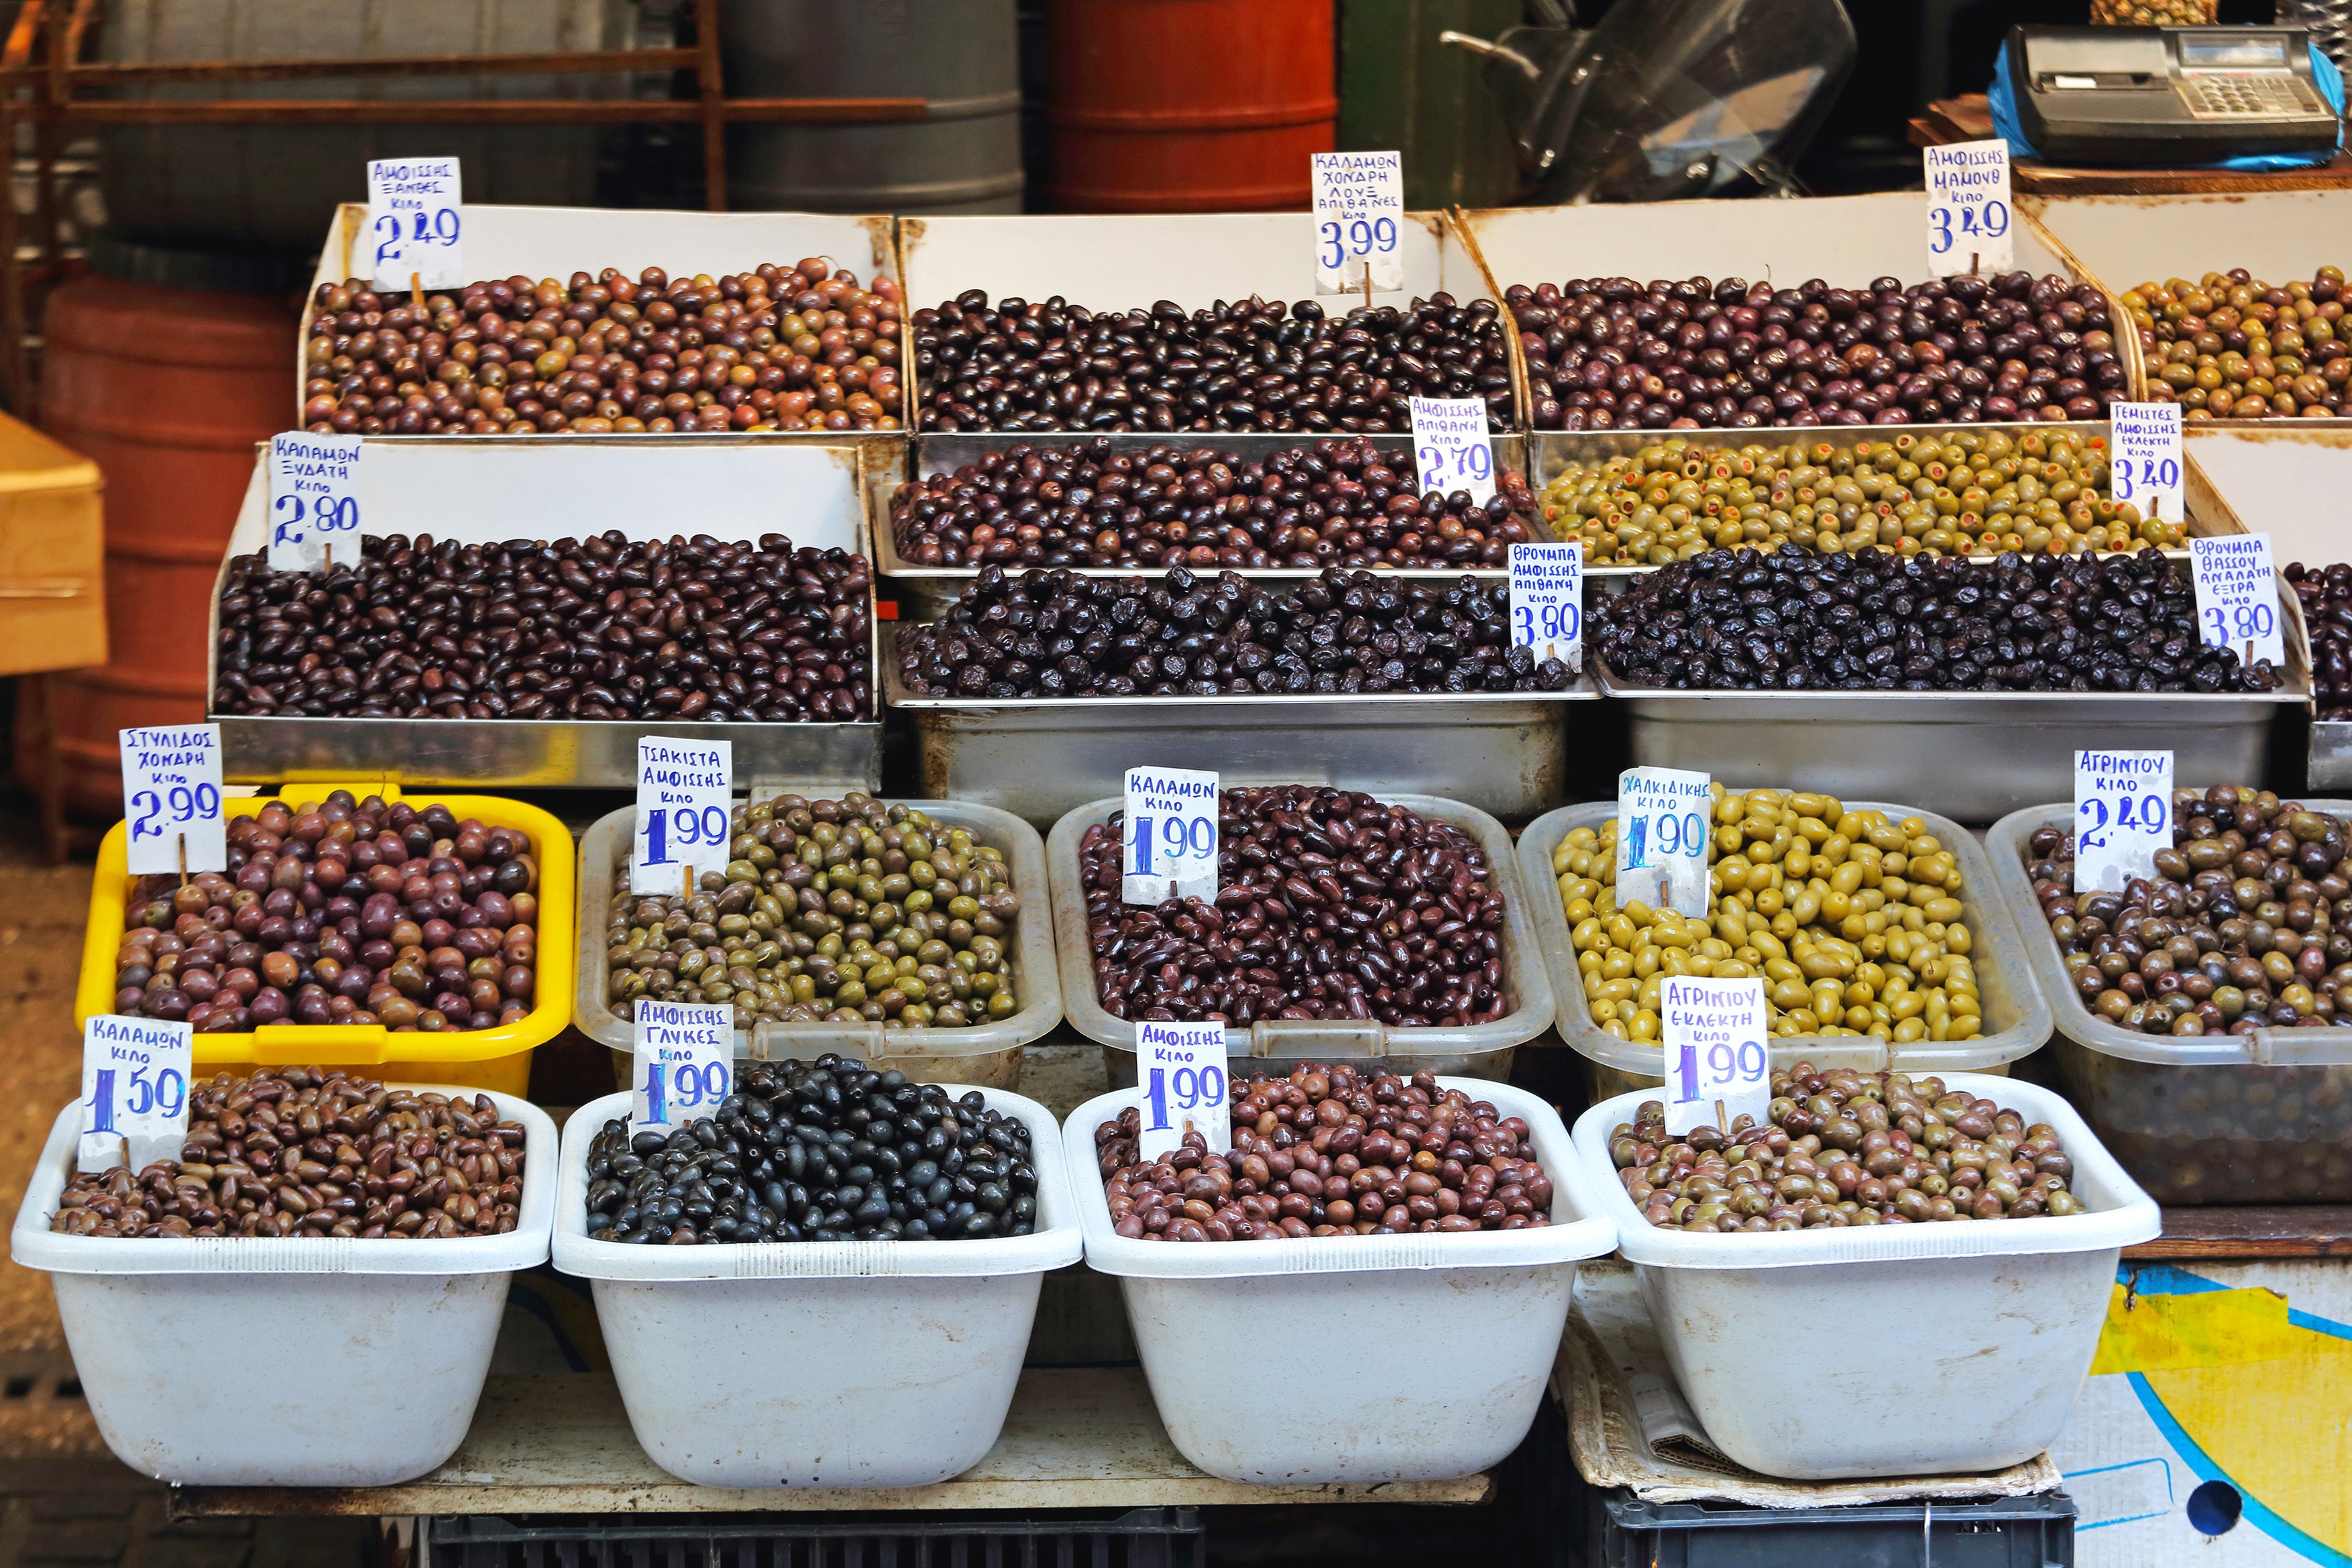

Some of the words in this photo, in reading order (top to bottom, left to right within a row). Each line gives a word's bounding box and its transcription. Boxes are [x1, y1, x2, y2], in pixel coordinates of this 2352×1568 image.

[1928, 148, 2004, 166] ΑΜΦΙΣΣΗΣ
[374, 162, 453, 181] ΑΜΦΙΣΣΗΣ
[1323, 171, 1388, 186] ΧΟΝΔΡΗ
[1935, 168, 2000, 189] ΜΑΜΟΥΘ
[1329, 186, 1378, 199] ΛΟΥΞ
[1952, 190, 1983, 204] ΚΙΛΟ
[391, 198, 423, 210] ΚΙΛΟ
[1319, 197, 1399, 209] ΑΠΙΘΑΝΕΣ
[1342, 211, 1366, 220] ΚΙΛΟ
[1930, 201, 2009, 254] 3.49
[375, 208, 460, 267] 2.49
[1321, 217, 1397, 270] 3.99
[1413, 398, 1484, 417] ΑΜΦΙΣΣΗΣ
[2115, 405, 2174, 421] ΓΕΜΙΣΤΕΣ
[1417, 419, 1477, 432] ΑΠΙΘΑΝΗ
[2115, 422, 2178, 435] ΑΜΦΙΣΣΗΣ
[1431, 435, 1461, 445] ΚΙΛΟ
[2122, 437, 2170, 446] ΕΚΛΕΚΤΗ
[2127, 448, 2154, 457] ΚΙΛΟ
[282, 460, 348, 480] ΞΥΔΑΤΗ
[1419, 443, 1491, 493] 2.79
[295, 480, 331, 493] ΚΙΛΟ
[1514, 545, 1577, 561] ΘΡΟΥΜΠΑ
[2194, 539, 2263, 555] ΘΡΟΥΜΠΑ
[1513, 563, 1579, 577] ΑΜΦΙΣΣΗΣ
[2202, 556, 2257, 572] ΘΑΣΣΟΥ
[2200, 566, 2271, 584] ΑΝΑΛΑΤΗ
[1514, 578, 1573, 591] ΑΠΙΘΑΝΗ
[2213, 581, 2255, 595] ΕΞΤΡΑ
[1528, 594, 1557, 604] ΚΙΛΟ
[126, 729, 215, 748] ΣΤΥΛΙΔΟΣ
[138, 751, 205, 770] ΧΟΝΔΡΗ
[640, 745, 721, 768] ΤΣΑΚΙΣΤΑ
[2080, 751, 2164, 774] ΑΓΡΙΝΙΟΥ
[152, 773, 187, 784] ΚΙΛΟ
[643, 767, 726, 788] ΑΜΦΙΣΣΗΣ
[1623, 775, 1711, 797] ΧΑΛΚΙΔΙΚΗΣ
[2096, 777, 2137, 792] ΚΙΛΟ
[661, 791, 693, 804] ΚΙΛΟ
[1145, 797, 1183, 812] ΚΙΛΟ
[1637, 796, 1677, 810] ΚΙΛΟ
[131, 783, 219, 843] 2.99
[2079, 795, 2166, 855] 2.49
[639, 805, 728, 867] 1.99
[1622, 813, 1705, 872] 1.99
[1124, 816, 1217, 877] 1.99
[1669, 982, 1756, 1007] ΑΓΡΙΝΙΟΥ
[640, 1001, 728, 1026] ΑΜΦΙΣΣΗΣ
[1671, 1010, 1752, 1027] ΕΚΛΕΚΤΗ
[647, 1026, 720, 1045] ΓΛΥΚΕΣ
[1142, 1024, 1224, 1046] ΑΜΦΙΣΣΗΣ
[1693, 1030, 1730, 1042] ΚΙΛΟ
[659, 1048, 693, 1061] ΚΙΛΟ
[1155, 1048, 1194, 1062] ΚΙΛΟ
[1672, 1040, 1766, 1104] 1.99
[82, 1066, 186, 1137] 1.59
[636, 1061, 730, 1126] 1.99
[1143, 1066, 1225, 1132] 1.99
